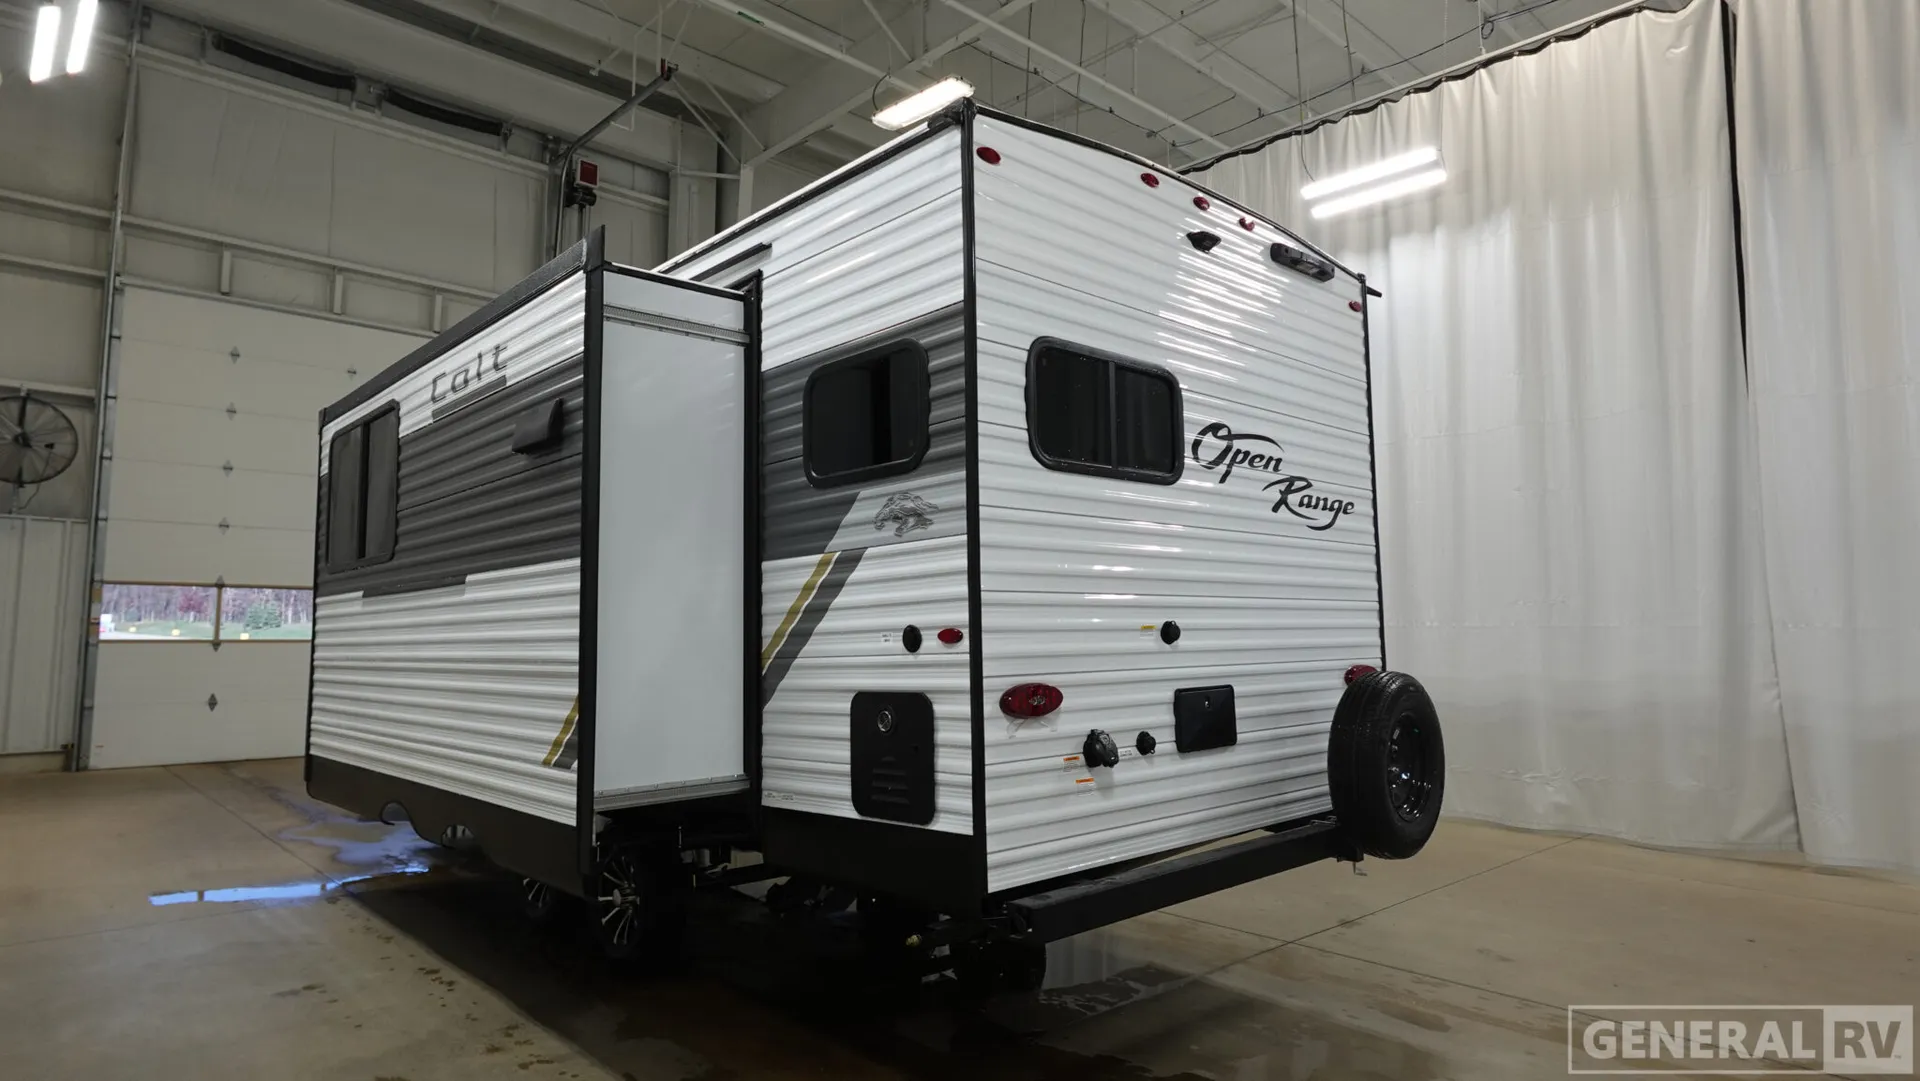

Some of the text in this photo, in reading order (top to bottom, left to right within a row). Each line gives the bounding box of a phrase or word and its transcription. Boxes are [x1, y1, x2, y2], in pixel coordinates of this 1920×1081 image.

[431, 344, 508, 403] Colt
[1191, 422, 1285, 484] Open
[1262, 476, 1355, 531] Range
